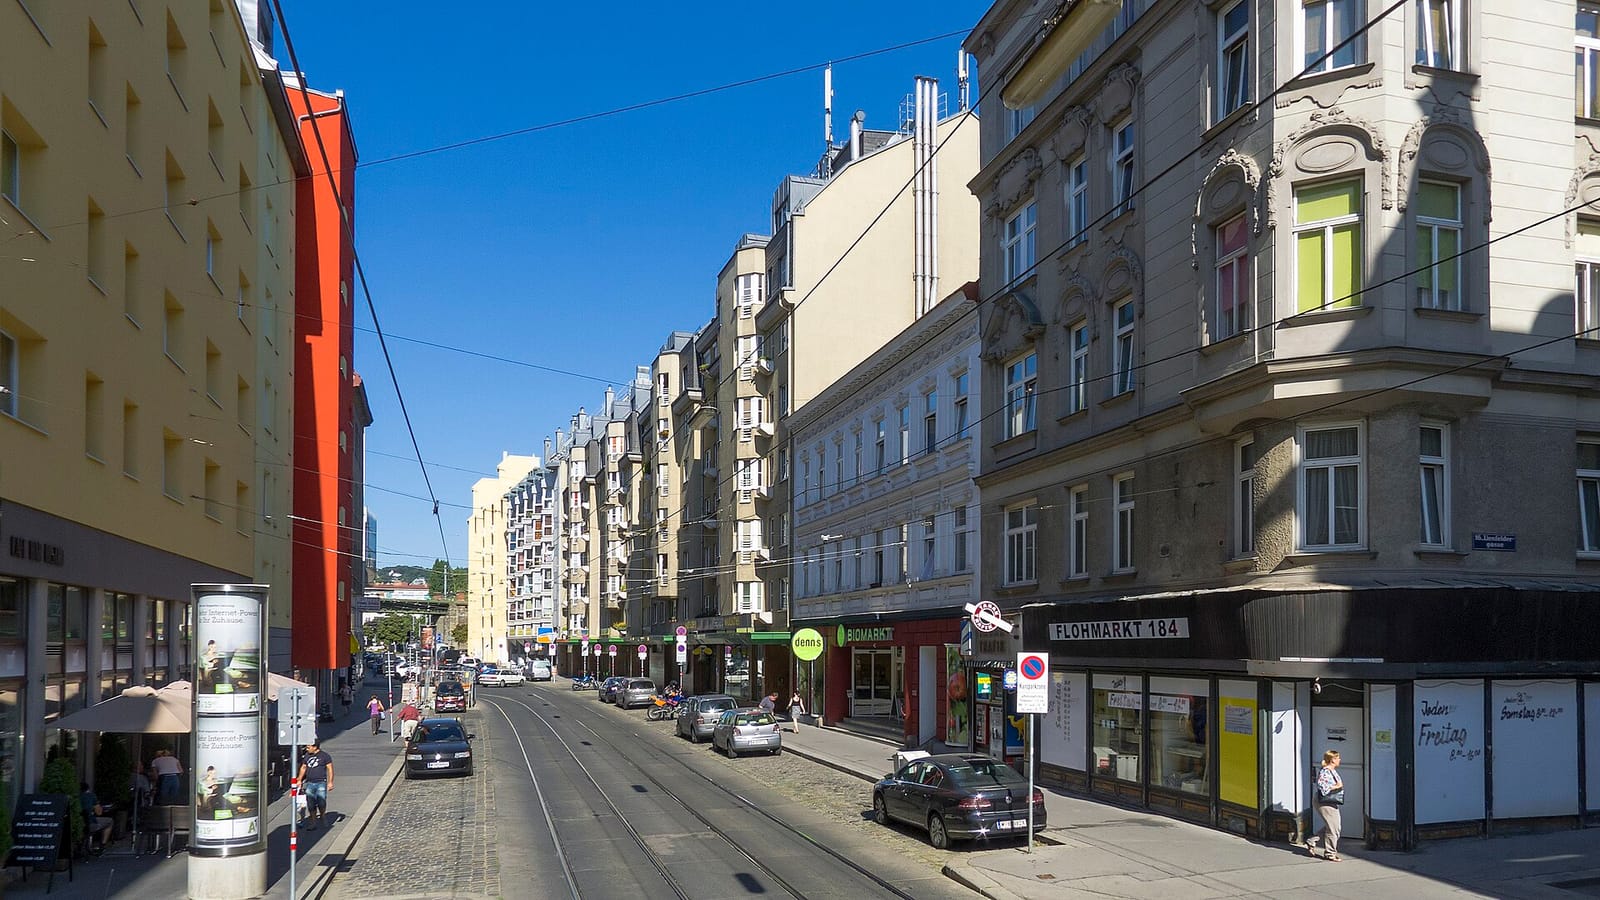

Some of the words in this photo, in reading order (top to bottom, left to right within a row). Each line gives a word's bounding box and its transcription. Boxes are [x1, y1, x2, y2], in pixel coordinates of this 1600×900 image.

[847, 627, 893, 642] BIOMARKT
[1056, 621, 1142, 640] FLOHMARKT
[1148, 619, 1178, 637] 184
[795, 637, 822, 648] denns
[1421, 700, 1449, 717] Jeden
[1500, 706, 1535, 722] Samstag
[1418, 722, 1467, 748] Freitag
